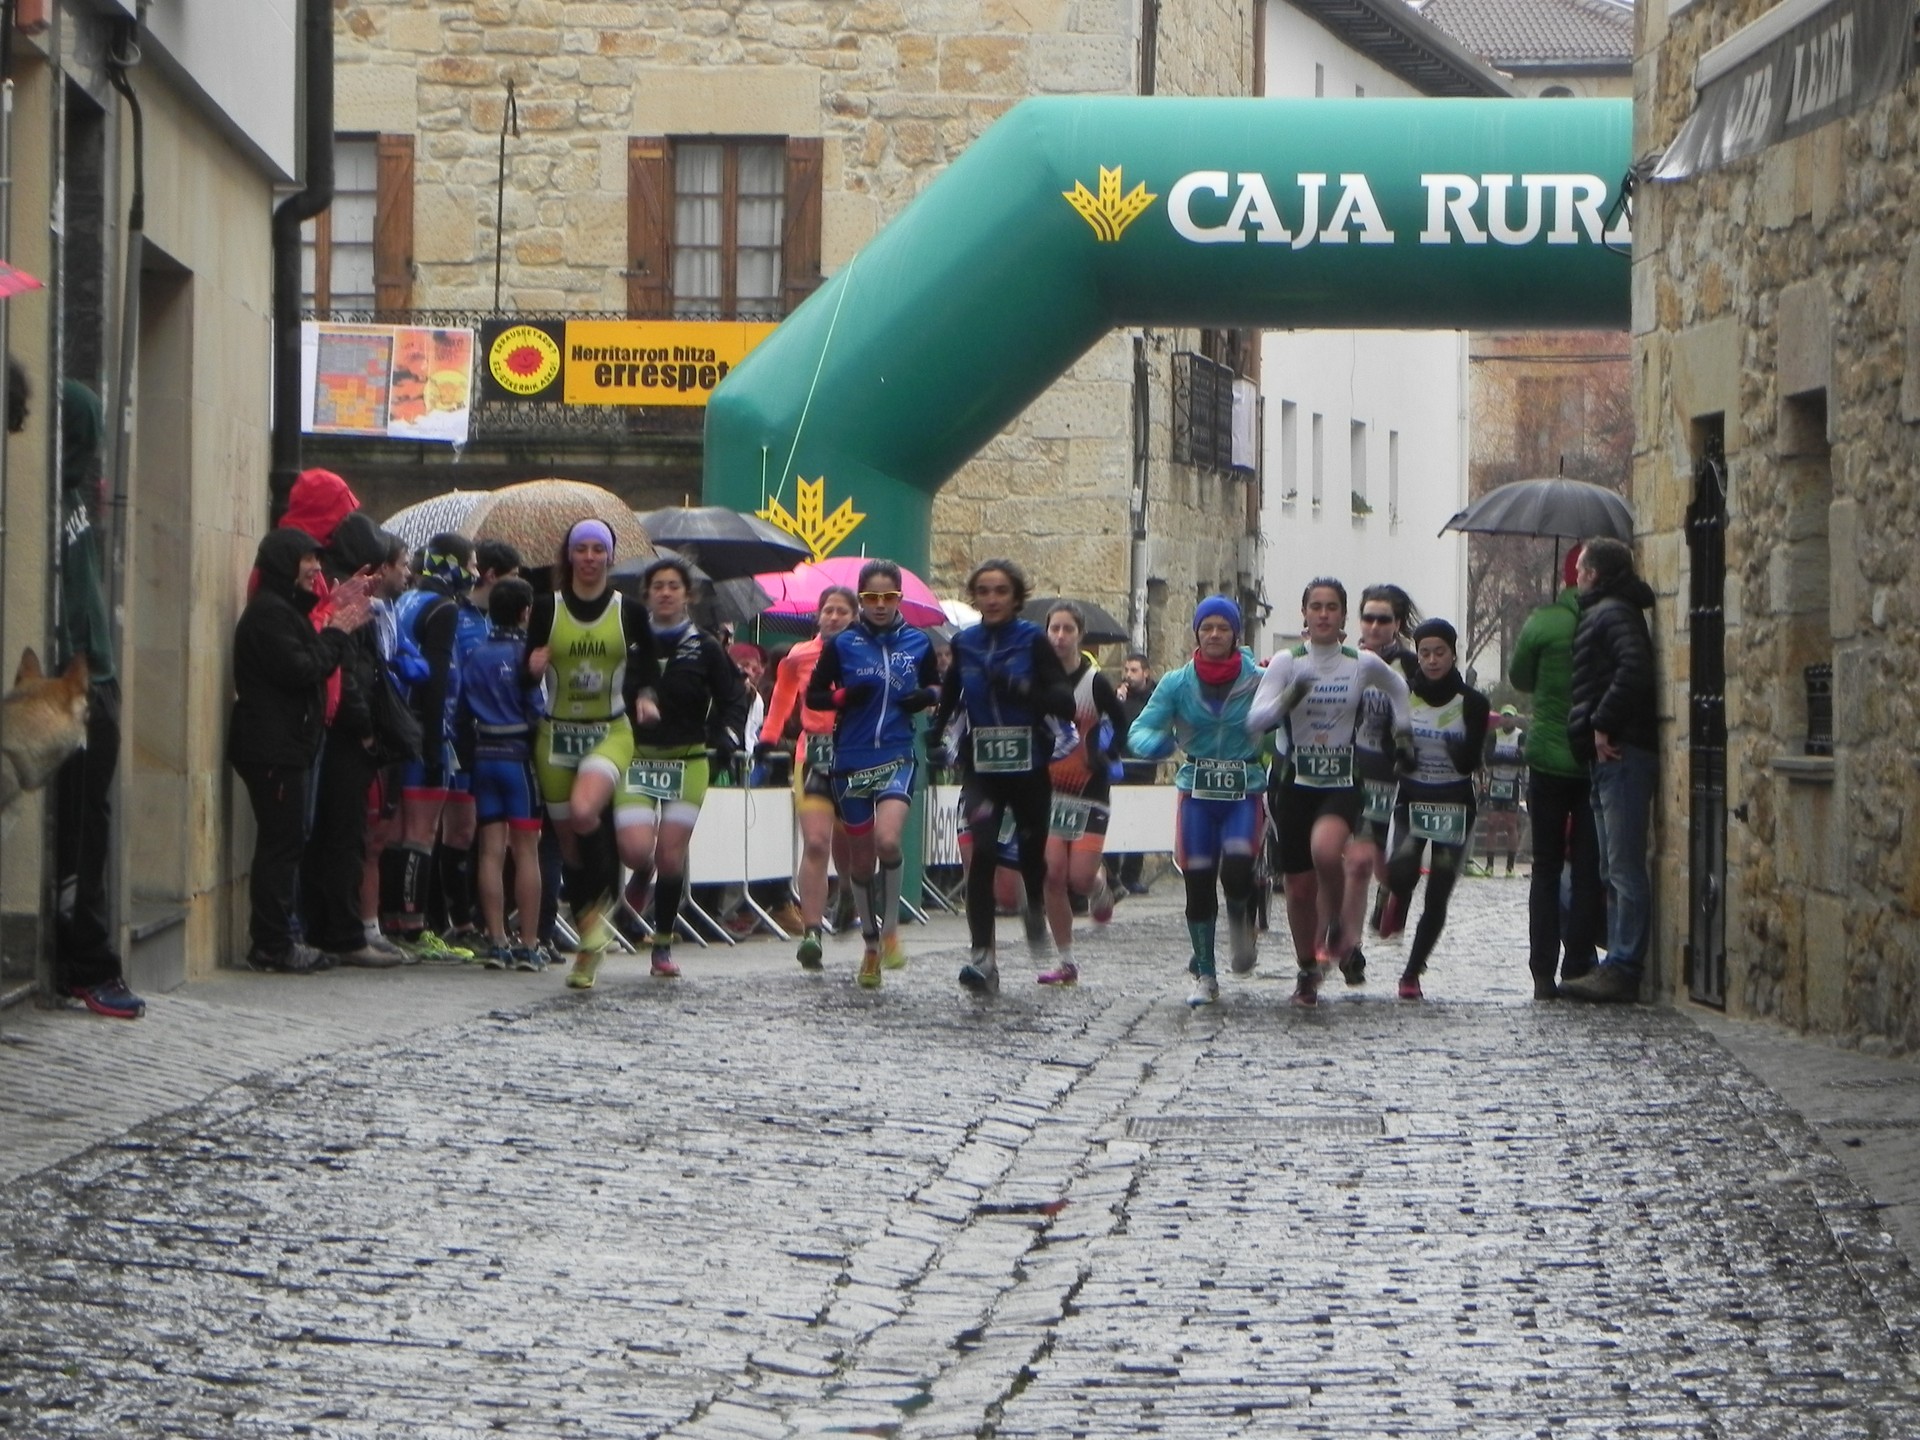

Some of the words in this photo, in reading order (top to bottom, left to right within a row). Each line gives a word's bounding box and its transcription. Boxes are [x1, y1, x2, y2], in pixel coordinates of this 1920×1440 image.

[1167, 171, 1395, 250] CAJA
[572, 344, 669, 363] Herritarron
[673, 346, 716, 363] hitza
[569, 640, 607, 657] AMAIA
[856, 667, 874, 677] CLUB
[874, 668, 903, 691] TRITLON
[1314, 685, 1348, 693] SALTOKI
[985, 740, 1018, 758] 115
[632, 760, 650, 769] CAJA
[652, 761, 680, 769] RURAL
[1308, 758, 1340, 775] 125
[639, 771, 671, 788] 110
[1204, 771, 1235, 788] 116
